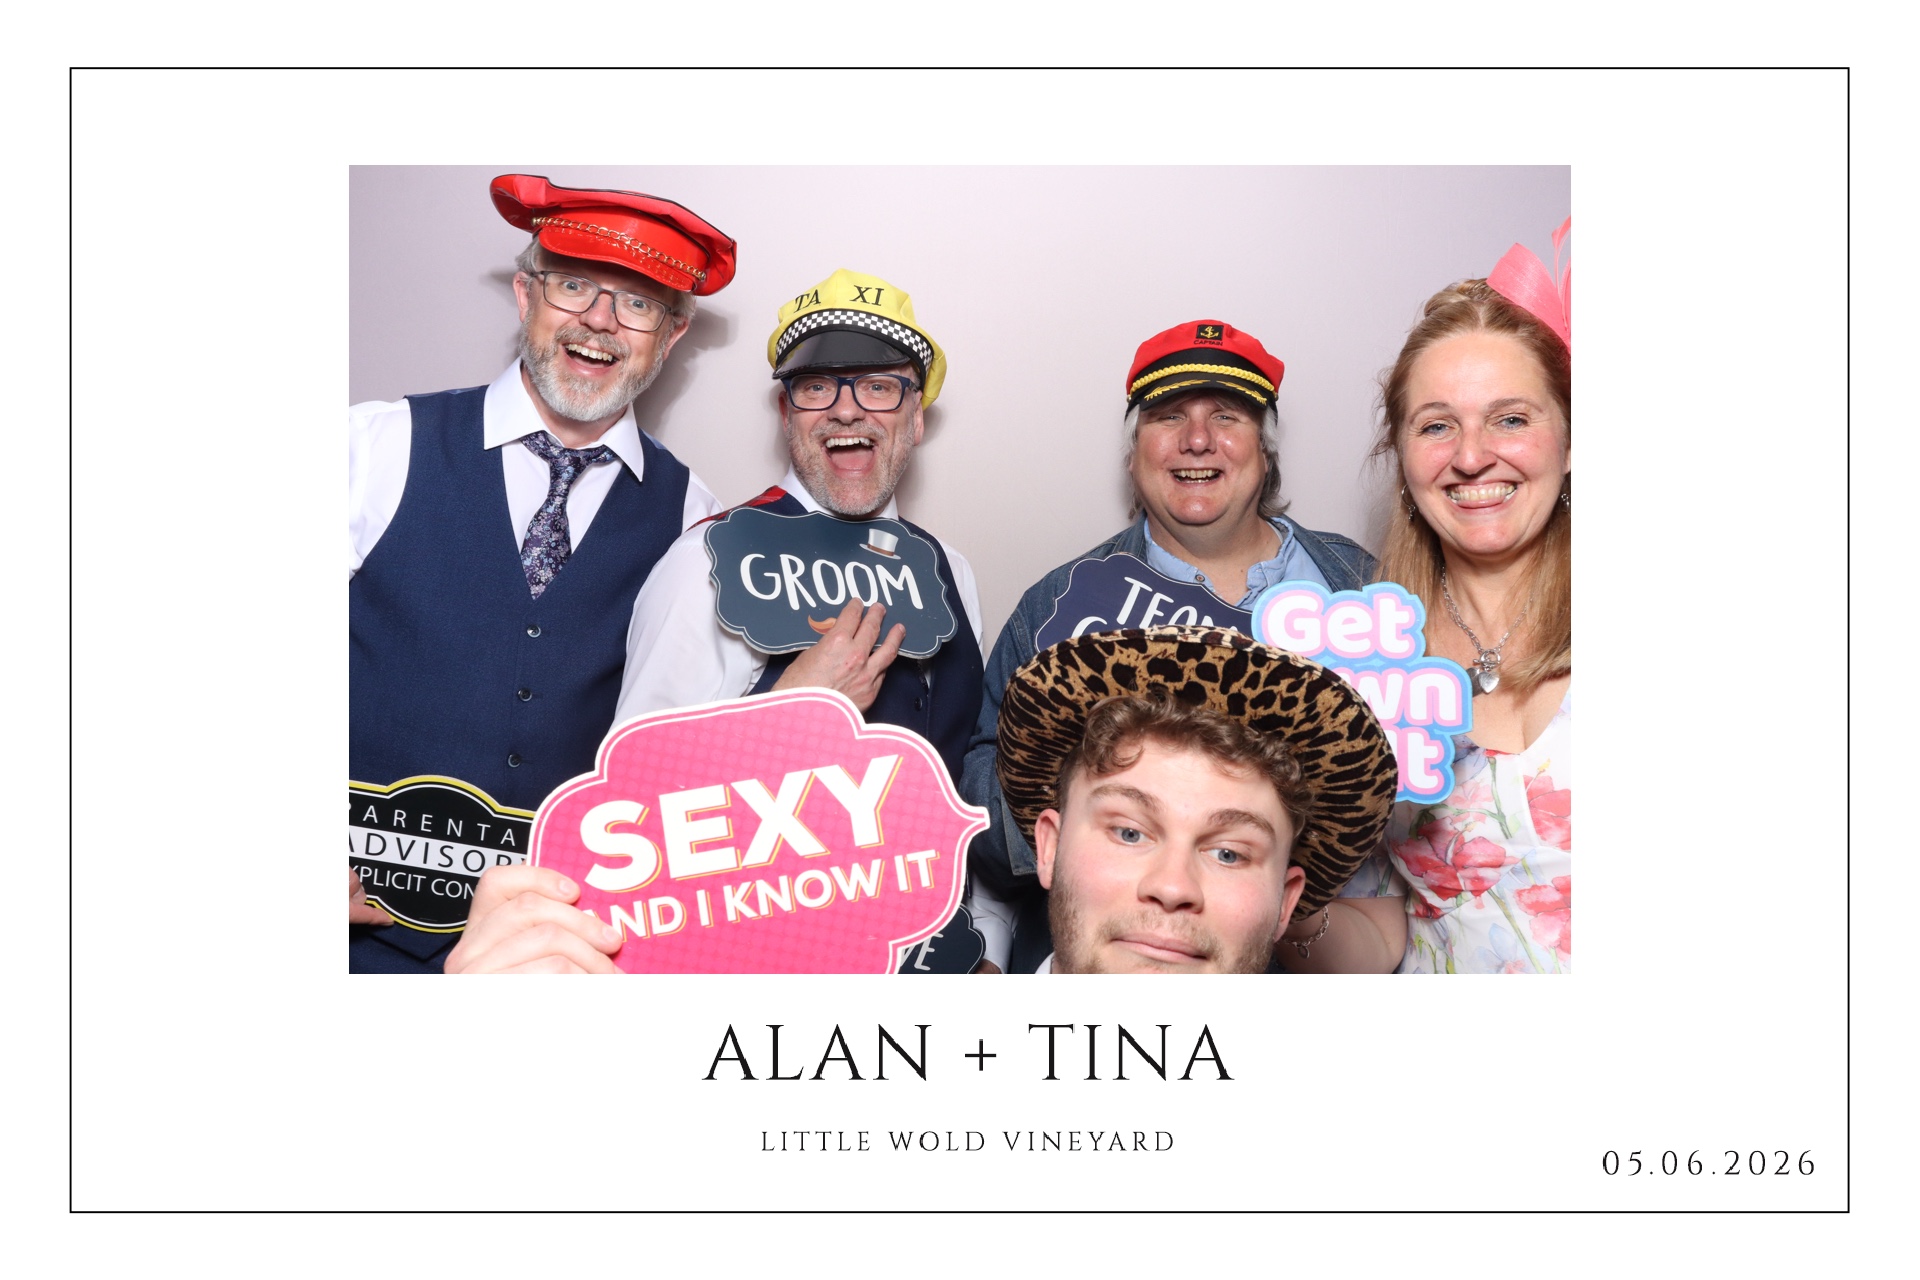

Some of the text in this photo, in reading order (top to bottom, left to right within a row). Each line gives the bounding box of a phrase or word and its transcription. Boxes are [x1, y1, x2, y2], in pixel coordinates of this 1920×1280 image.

[1193, 339, 1224, 347] CAPTAIN
[740, 553, 923, 610] GROOM
[1116, 576, 1239, 631] TE
[1265, 595, 1411, 653] Get
[1341, 673, 1456, 721] wn
[1383, 730, 1438, 789] t
[349, 802, 515, 847] ARENTA
[580, 754, 904, 893] SEXY
[349, 832, 525, 873] DVISO
[352, 865, 427, 892] PLICIT
[582, 849, 940, 942] ND I KNOW IT
